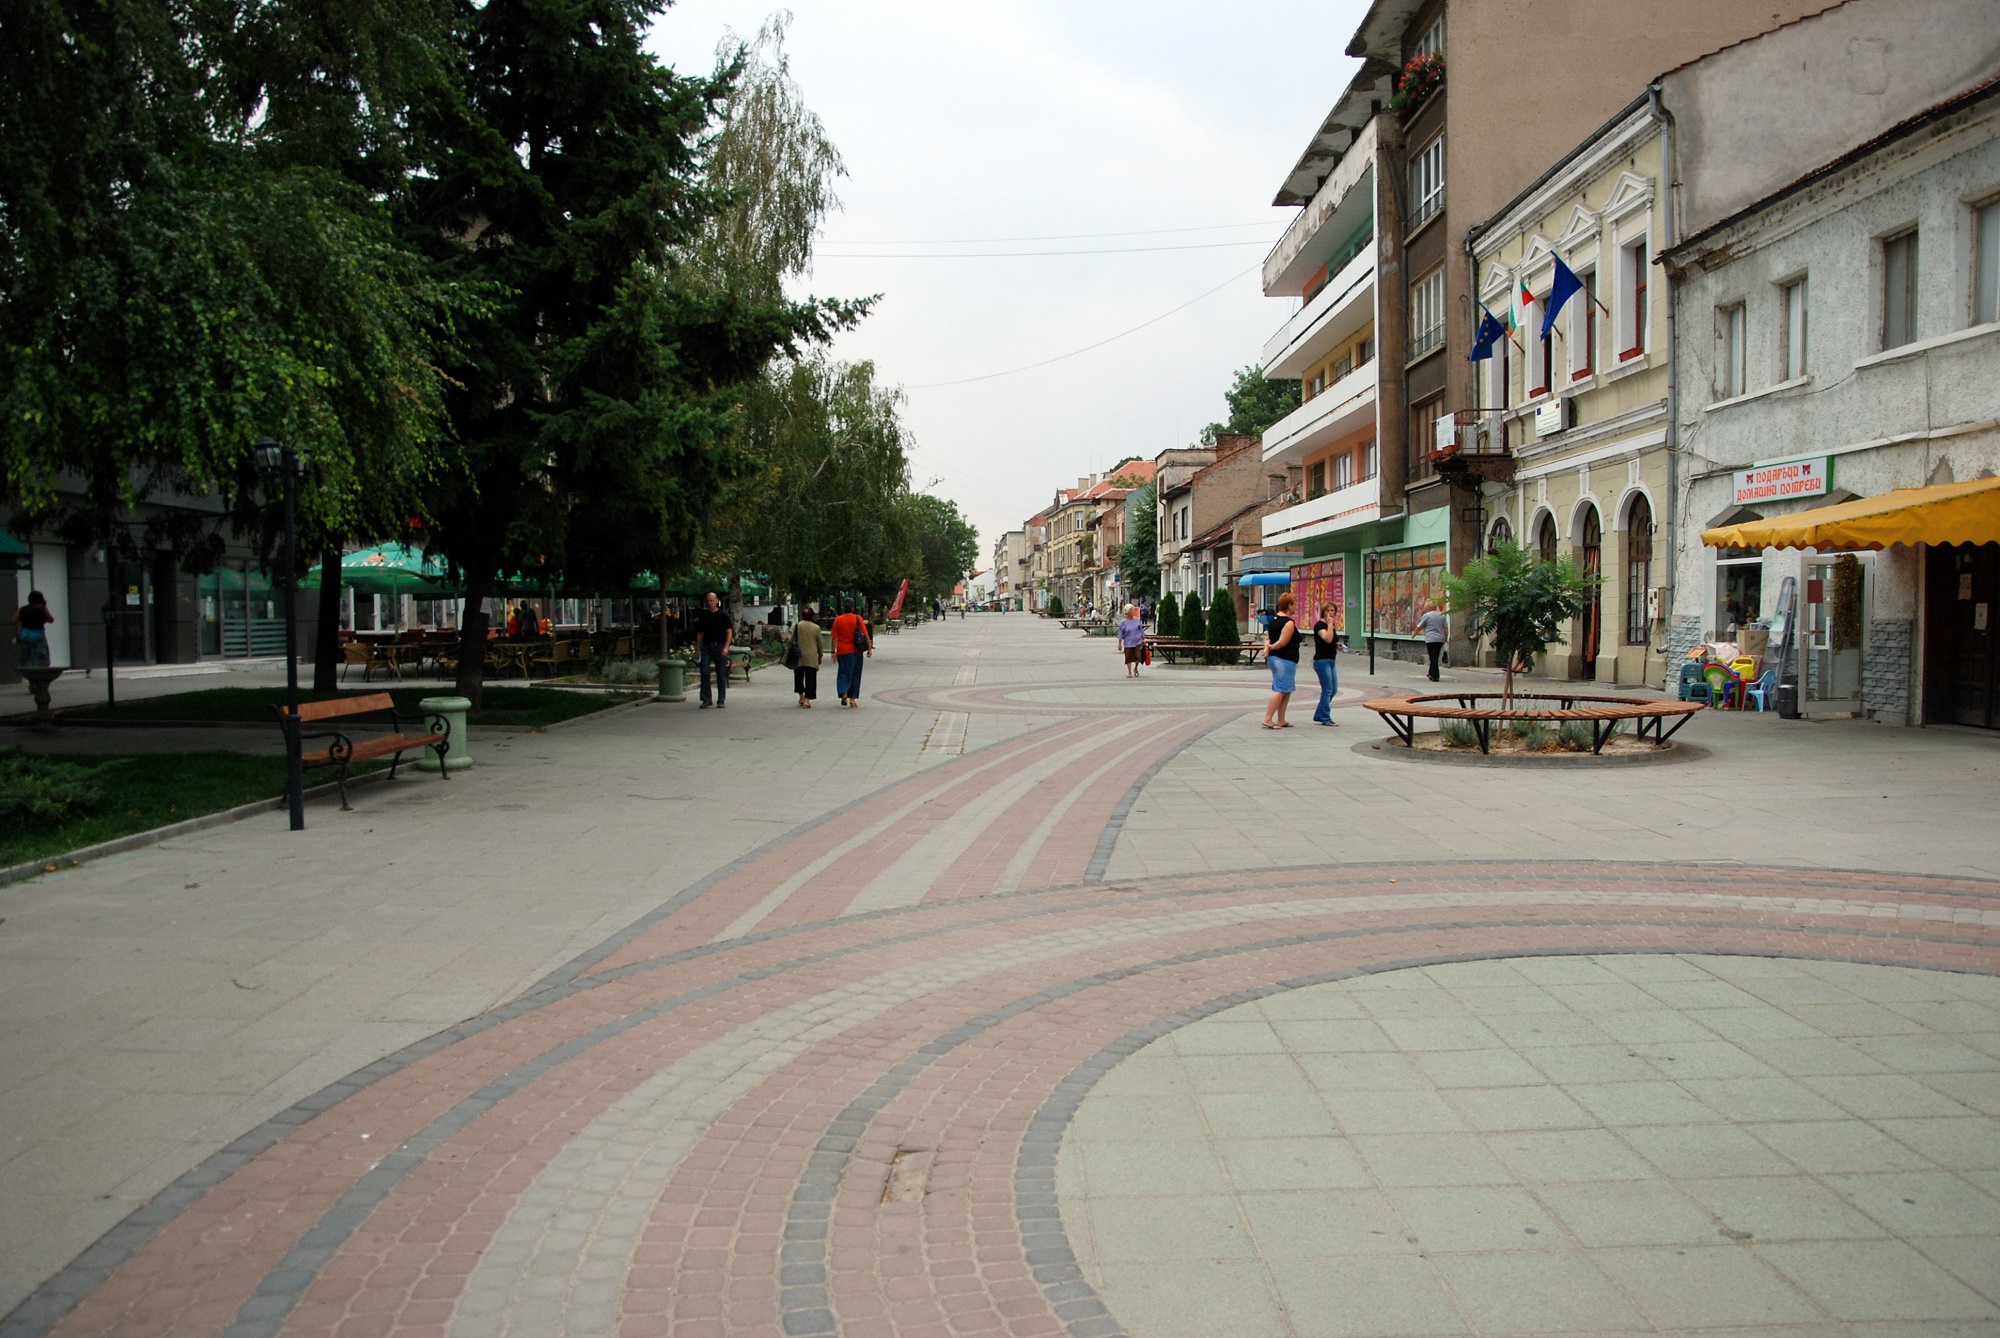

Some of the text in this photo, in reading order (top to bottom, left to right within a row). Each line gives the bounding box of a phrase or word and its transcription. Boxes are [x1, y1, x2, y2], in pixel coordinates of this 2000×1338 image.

[1756, 465, 1799, 484] ПОДАРЪЦИ
[1736, 477, 1822, 503] ДОМАШНИ ПОТРЕБИ
